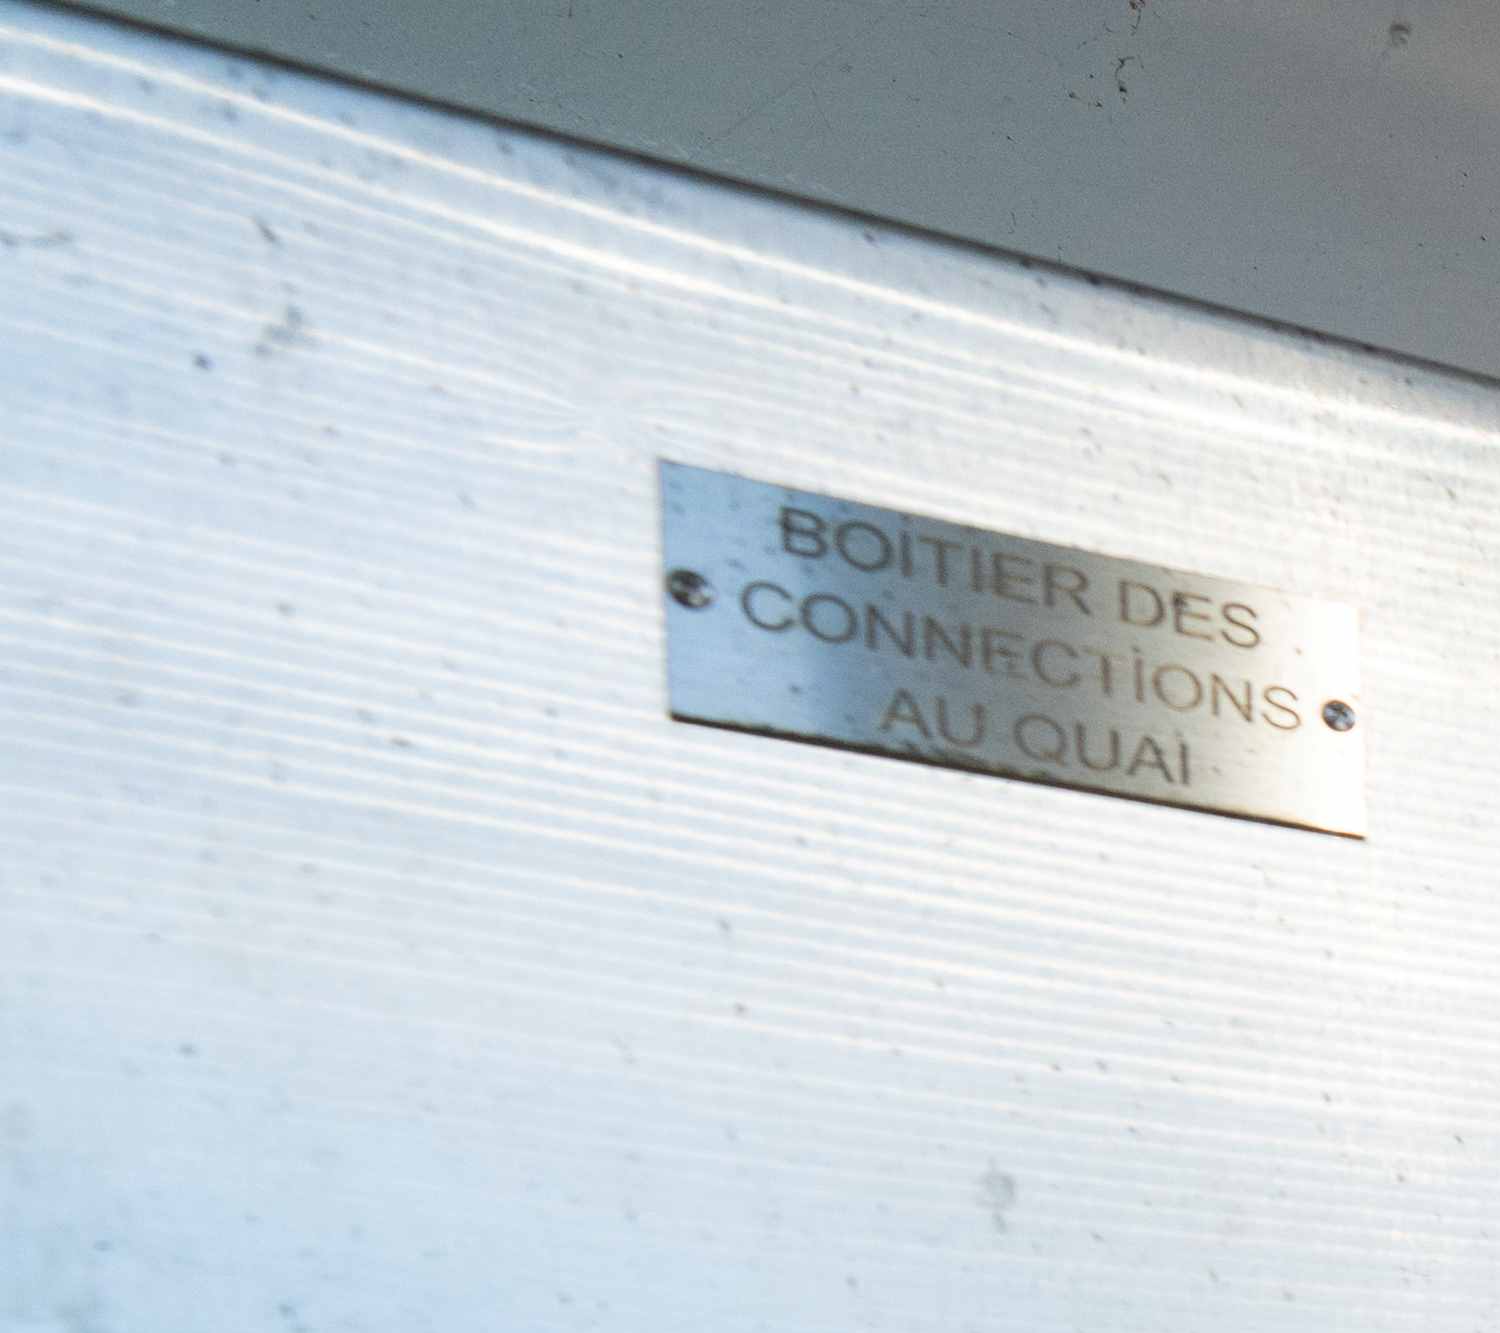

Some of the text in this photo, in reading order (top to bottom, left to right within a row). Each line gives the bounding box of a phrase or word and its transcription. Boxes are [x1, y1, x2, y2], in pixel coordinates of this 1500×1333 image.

[780, 507, 1262, 649] BOITIER DES
[740, 580, 1302, 730] CONNECTIONS
[880, 687, 1190, 785] AU QUAI
